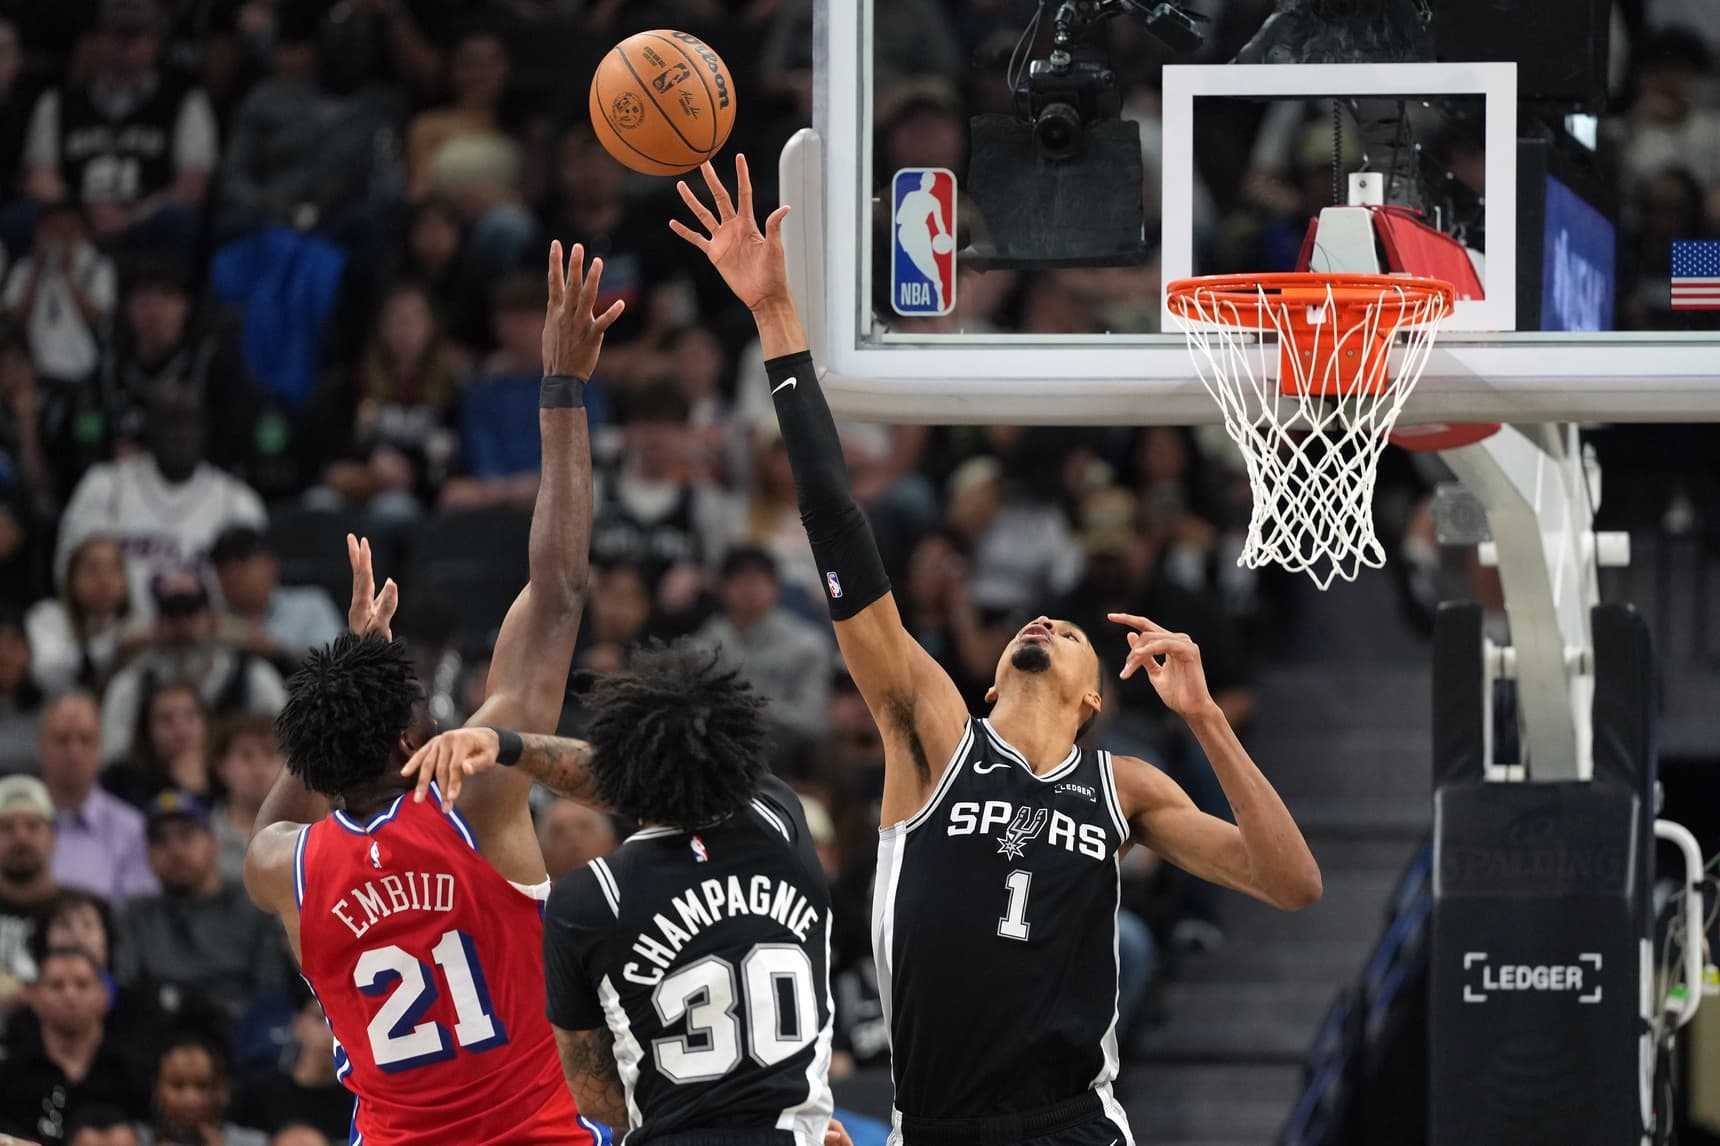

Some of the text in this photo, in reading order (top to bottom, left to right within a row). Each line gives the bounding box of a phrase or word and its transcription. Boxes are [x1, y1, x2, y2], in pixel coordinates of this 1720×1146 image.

[672, 31, 729, 110] Wilson
[900, 282, 931, 306] NBA
[1060, 783, 1092, 797] LEDGER
[947, 800, 1107, 861] SPURS
[331, 871, 455, 938] EMBIID
[623, 874, 819, 986] CHAMPAGNIE
[997, 868, 1033, 942] 1
[353, 928, 509, 1074] 21
[1482, 965, 1583, 990] LEDGER
[651, 942, 820, 1085] 30
